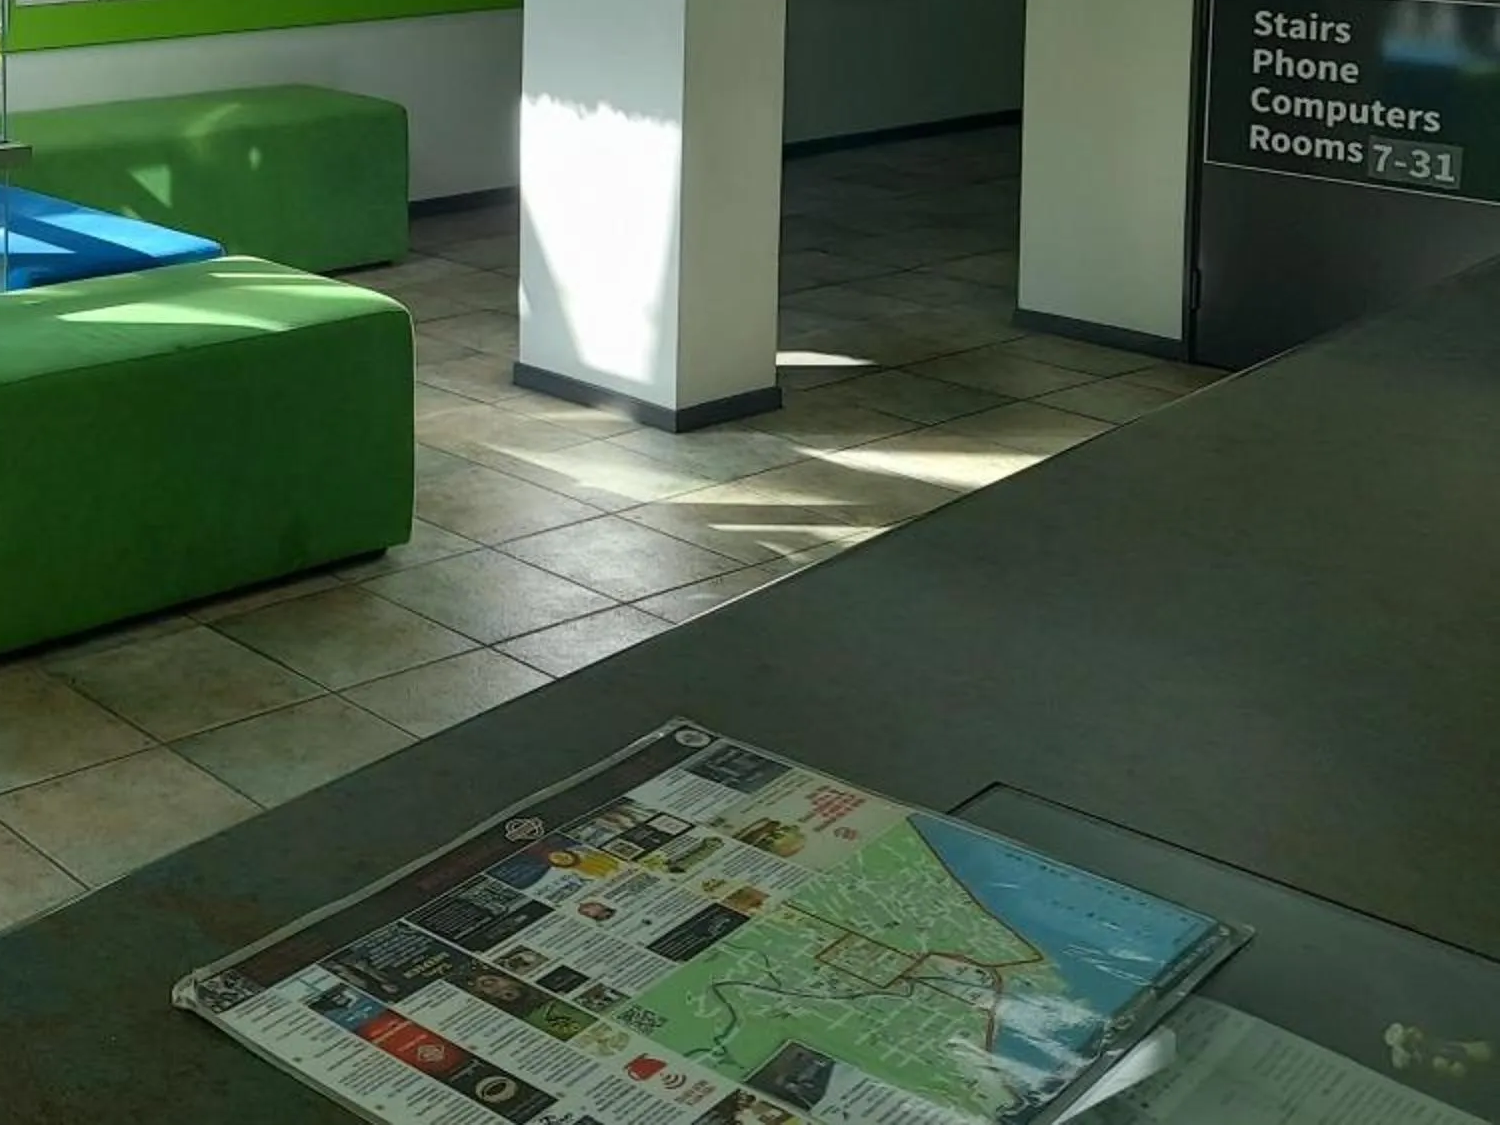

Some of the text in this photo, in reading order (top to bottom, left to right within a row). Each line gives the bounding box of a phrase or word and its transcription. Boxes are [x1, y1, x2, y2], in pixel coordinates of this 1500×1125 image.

[1253, 10, 1352, 45] Stairs
[1252, 48, 1360, 85] Phone
[1250, 87, 1442, 133] Computers
[1249, 124, 1456, 184] Rooms 7-31
